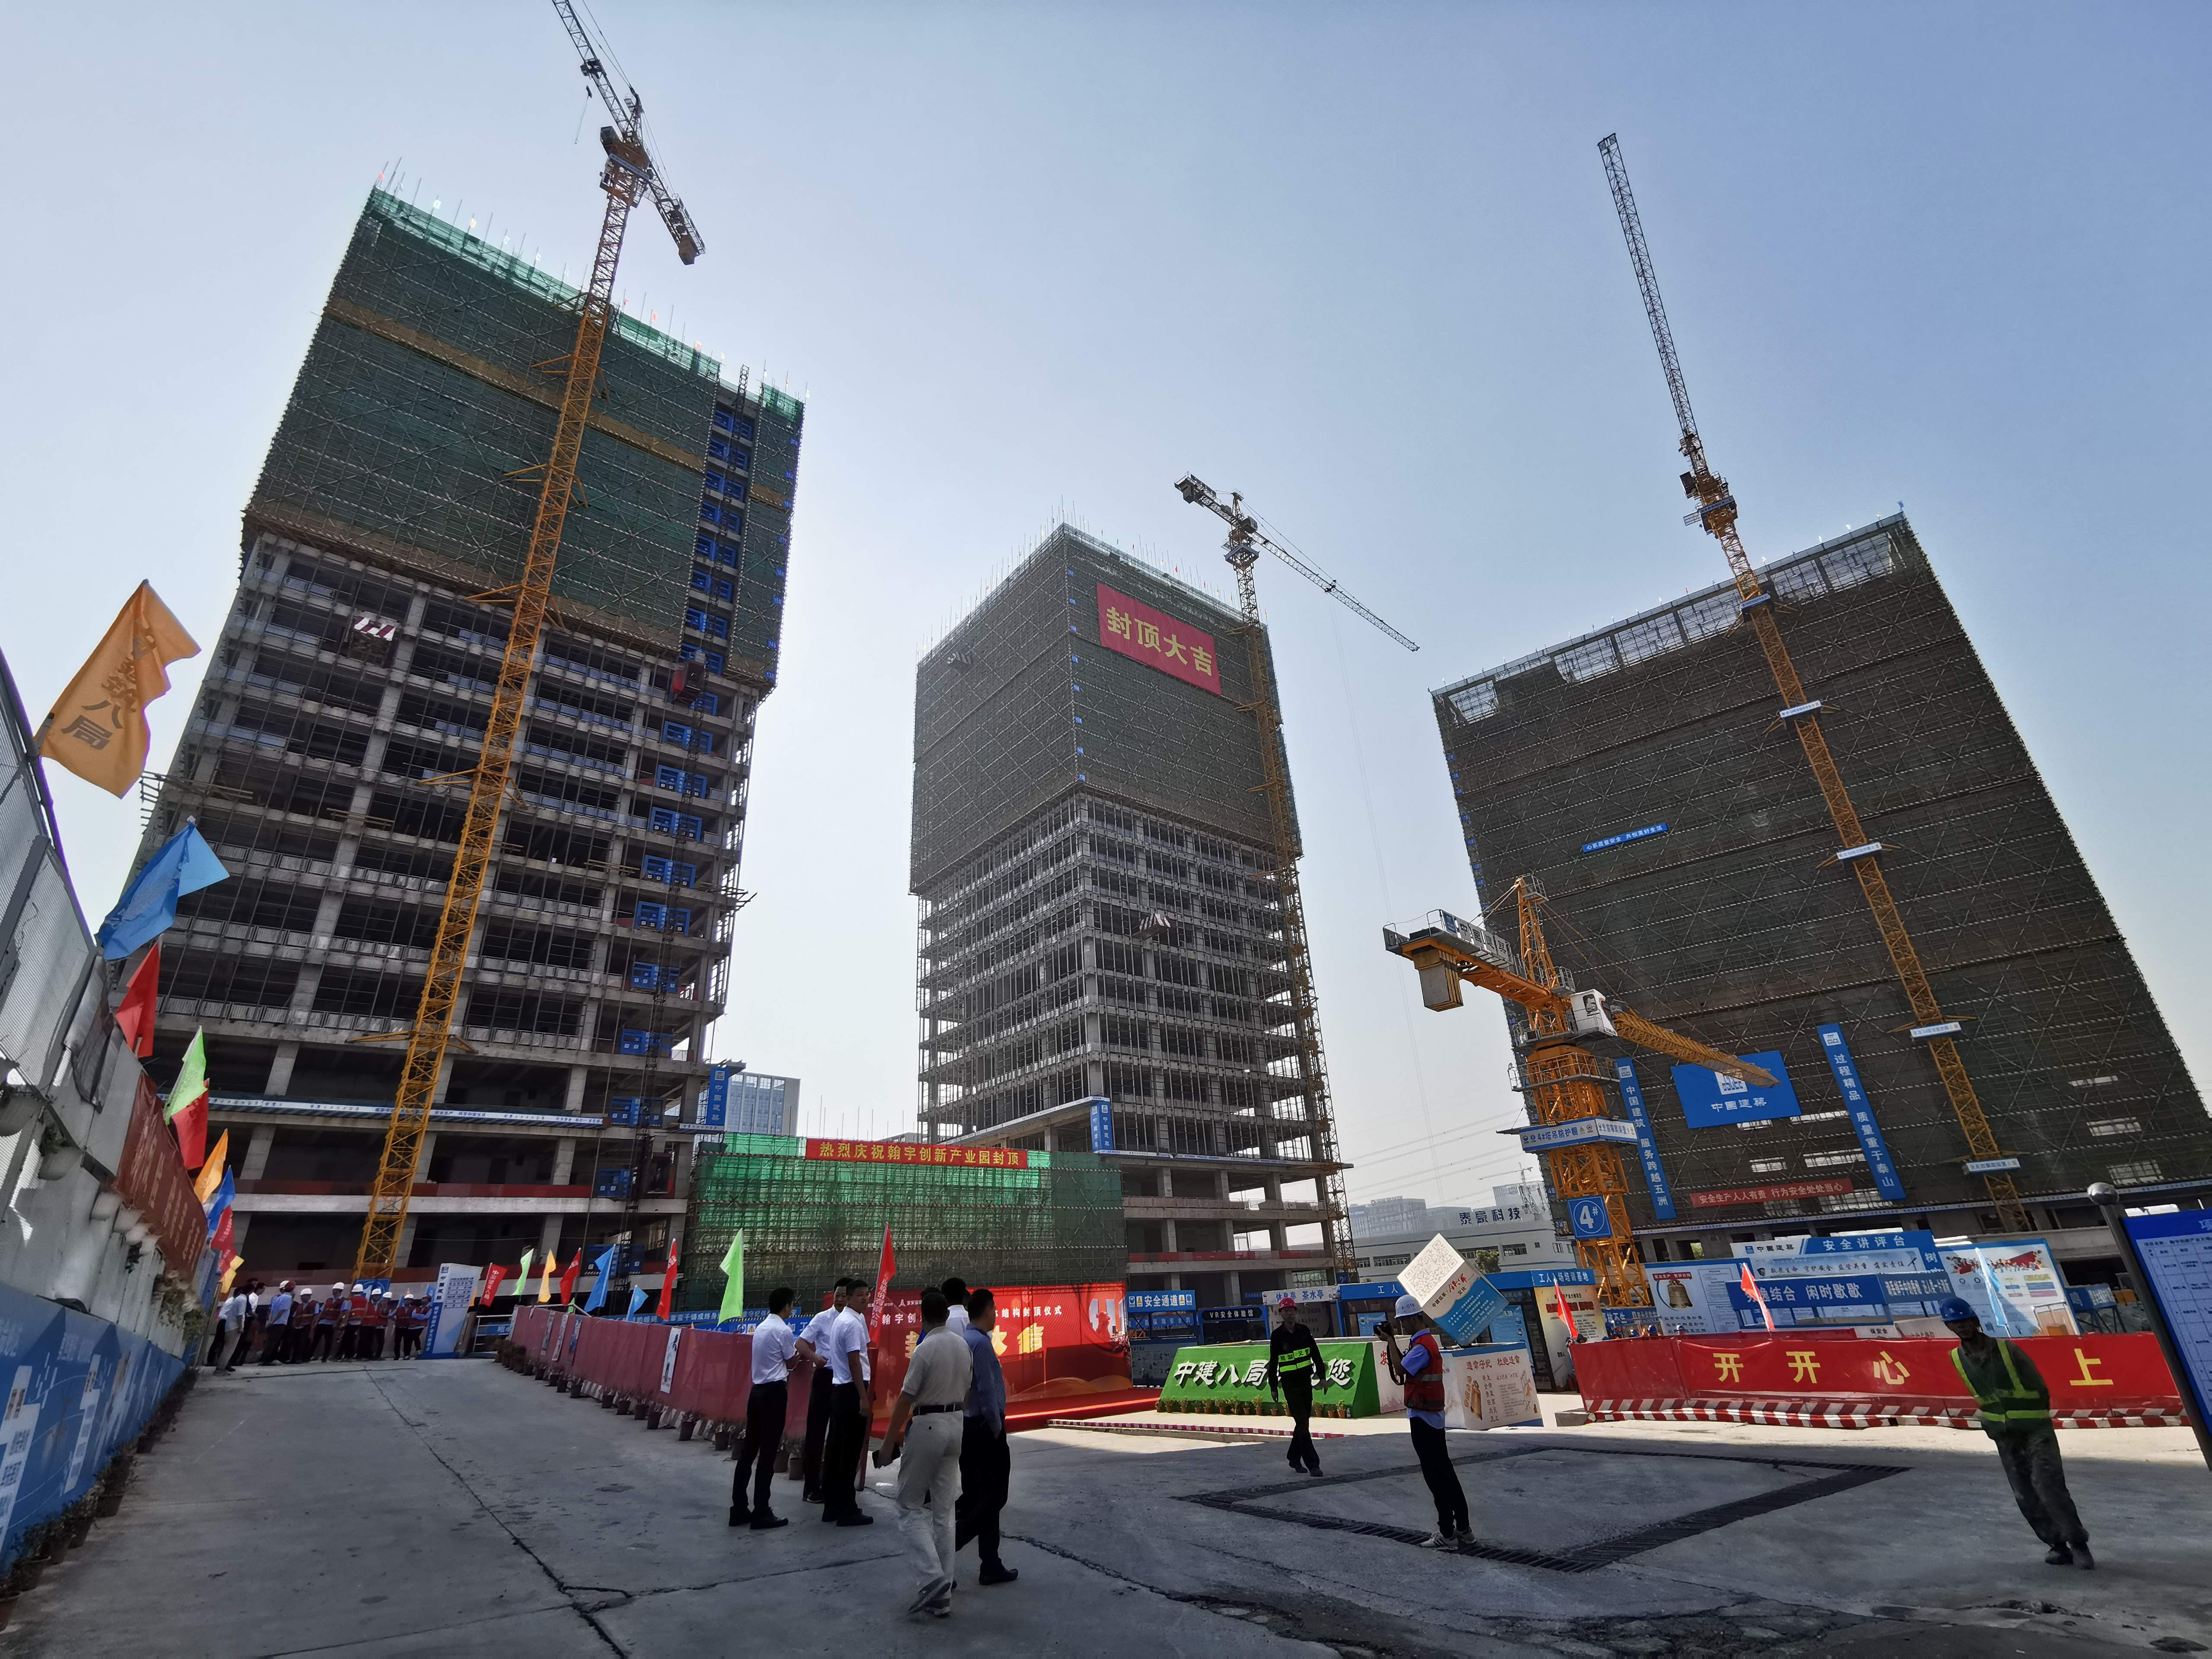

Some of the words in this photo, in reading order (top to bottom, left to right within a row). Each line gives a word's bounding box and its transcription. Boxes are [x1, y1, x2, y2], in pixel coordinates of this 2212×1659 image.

[1106, 606, 1212, 676] 封顶大吉
[1833, 1054, 1861, 1102] 过程精品
[1856, 1112, 1894, 1188] 质量重于泰山
[820, 1142, 1019, 1166] 热烈庆祝翰宇创新产业园封顶
[1625, 1086, 1646, 1128] 中国建筑
[1640, 1138, 1669, 1207] 服务跨越五洲
[1699, 1189, 1767, 1205] 安全生产人人有责
[1771, 1182, 1844, 1197] 行为安全处处当心
[1459, 1207, 1522, 1225] 泰豪科技
[1823, 1235, 1905, 1251] 安全讲评台
[1925, 1252, 1938, 1263] 树
[1302, 1290, 1324, 1300] 茶水亭
[1377, 1284, 1398, 1294] 工人
[1805, 1282, 1863, 1301] 闲时歇歇
[1144, 1294, 1178, 1307] 安全通道
[882, 1312, 922, 1325] 翰宇创
[1209, 1309, 1254, 1319] VR安全体验馆
[1173, 1358, 1353, 1387] 中建八局您
